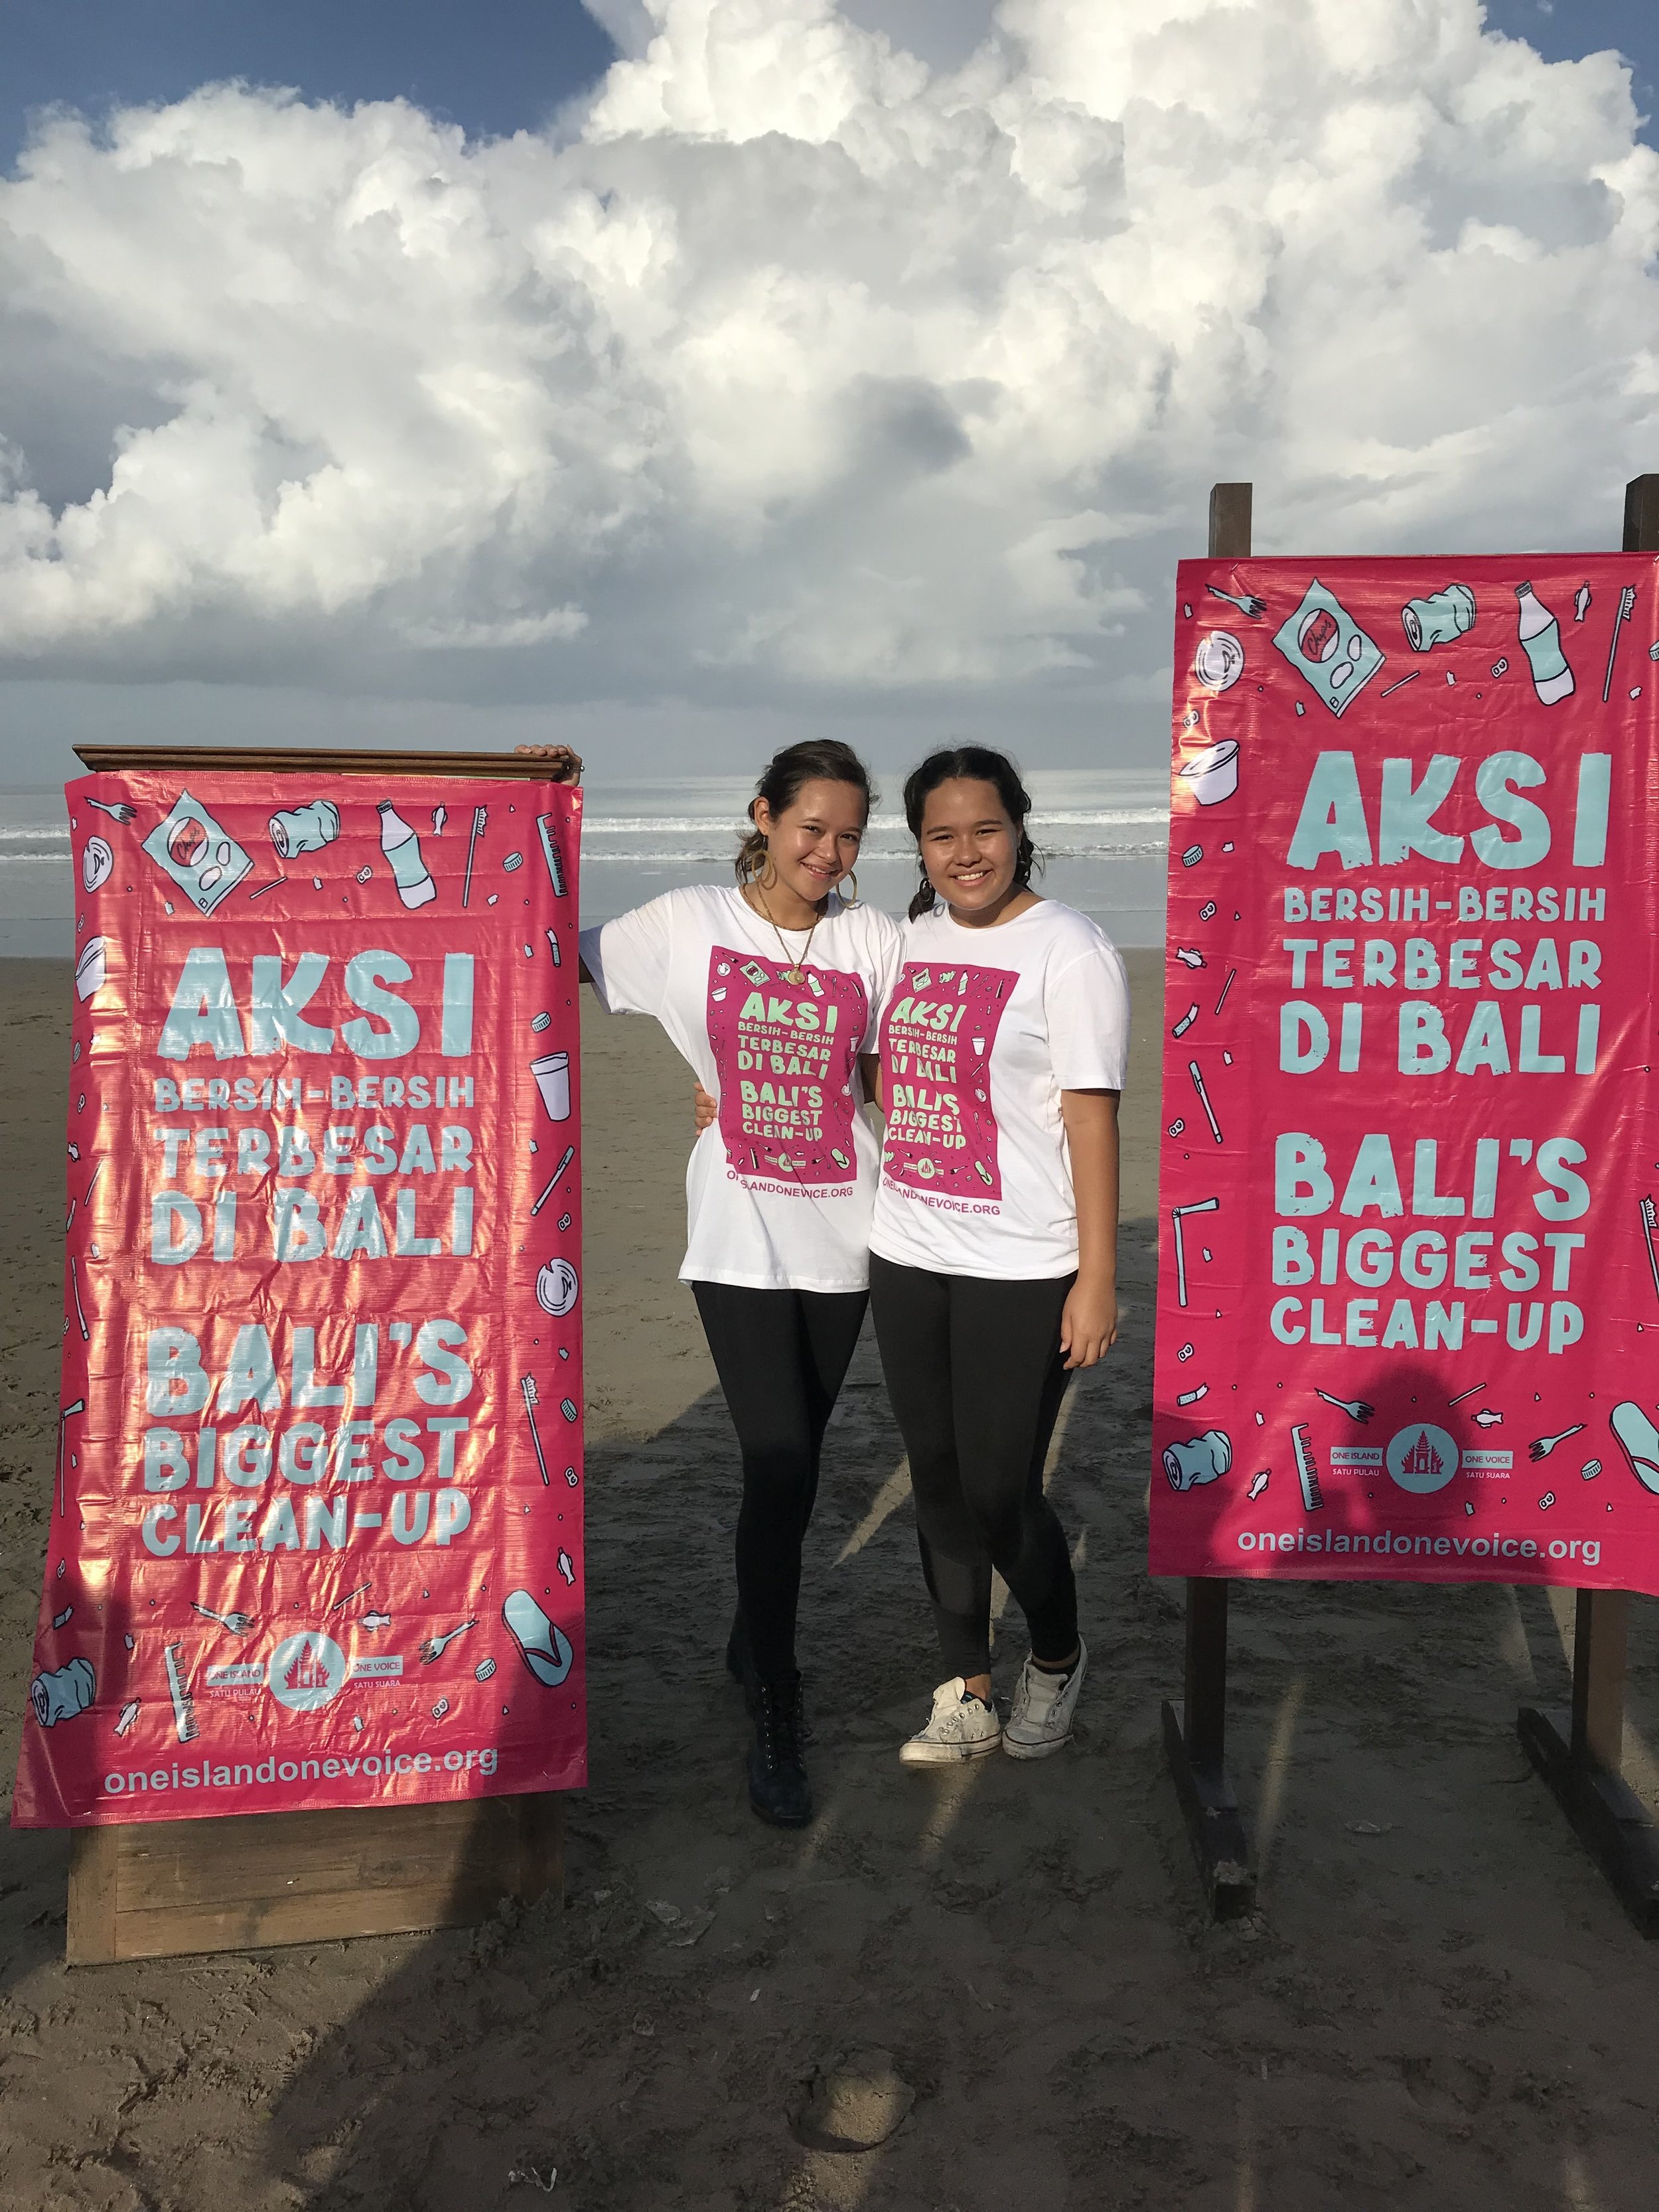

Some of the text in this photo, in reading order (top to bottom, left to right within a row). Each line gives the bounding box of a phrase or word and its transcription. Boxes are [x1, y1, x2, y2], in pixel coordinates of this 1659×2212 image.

[1287, 750, 1611, 869] AKSI
[1285, 887, 1605, 922] BERSIH-BERSIH
[1283, 938, 1602, 991] TERBESAR
[157, 947, 474, 1061] AKSI
[739, 992, 837, 1033] AKSI
[890, 996, 967, 1033] AKSI
[738, 1021, 834, 1045] BERSIH-BERSIH
[738, 1035, 831, 1062] TERBESAR
[889, 1025, 958, 1045] BERSIH-BERSIH
[1280, 1000, 1600, 1075] DI BALI
[738, 1050, 829, 1080] DI BALI
[889, 1038, 956, 1064] TERBESAR
[154, 1076, 474, 1112] BERSIH-BERSIH
[740, 1080, 823, 1108] BALI'S
[742, 1103, 823, 1126] BIGGEST
[743, 1121, 823, 1142] CLEAN-UP
[890, 1109, 962, 1133] BIGGEST
[153, 1124, 474, 1179] TERBESAR
[888, 1127, 966, 1149] CLEAN-UP
[1275, 1132, 1591, 1221] BALI'S
[151, 1186, 474, 1265] DI BALI
[1272, 1225, 1585, 1292] BIGGEST
[1270, 1296, 1584, 1354] CLEAN-UP
[146, 1319, 473, 1417] BALI'S
[144, 1417, 469, 1493] BIGGEST
[1351, 1452, 1380, 1461] ISLAND
[1485, 1455, 1510, 1464] VOICE
[142, 1488, 472, 1557] CLEAN-UP
[1237, 1527, 1601, 1566] oneislandonevoice.org
[210, 1671, 228, 1680] ONE
[353, 1661, 401, 1673] ONE VOICE
[353, 1679, 401, 1690] SATU SUARA
[209, 1688, 259, 1698] SATU PULAU
[104, 1746, 499, 1795] oneislandonevoice.org
